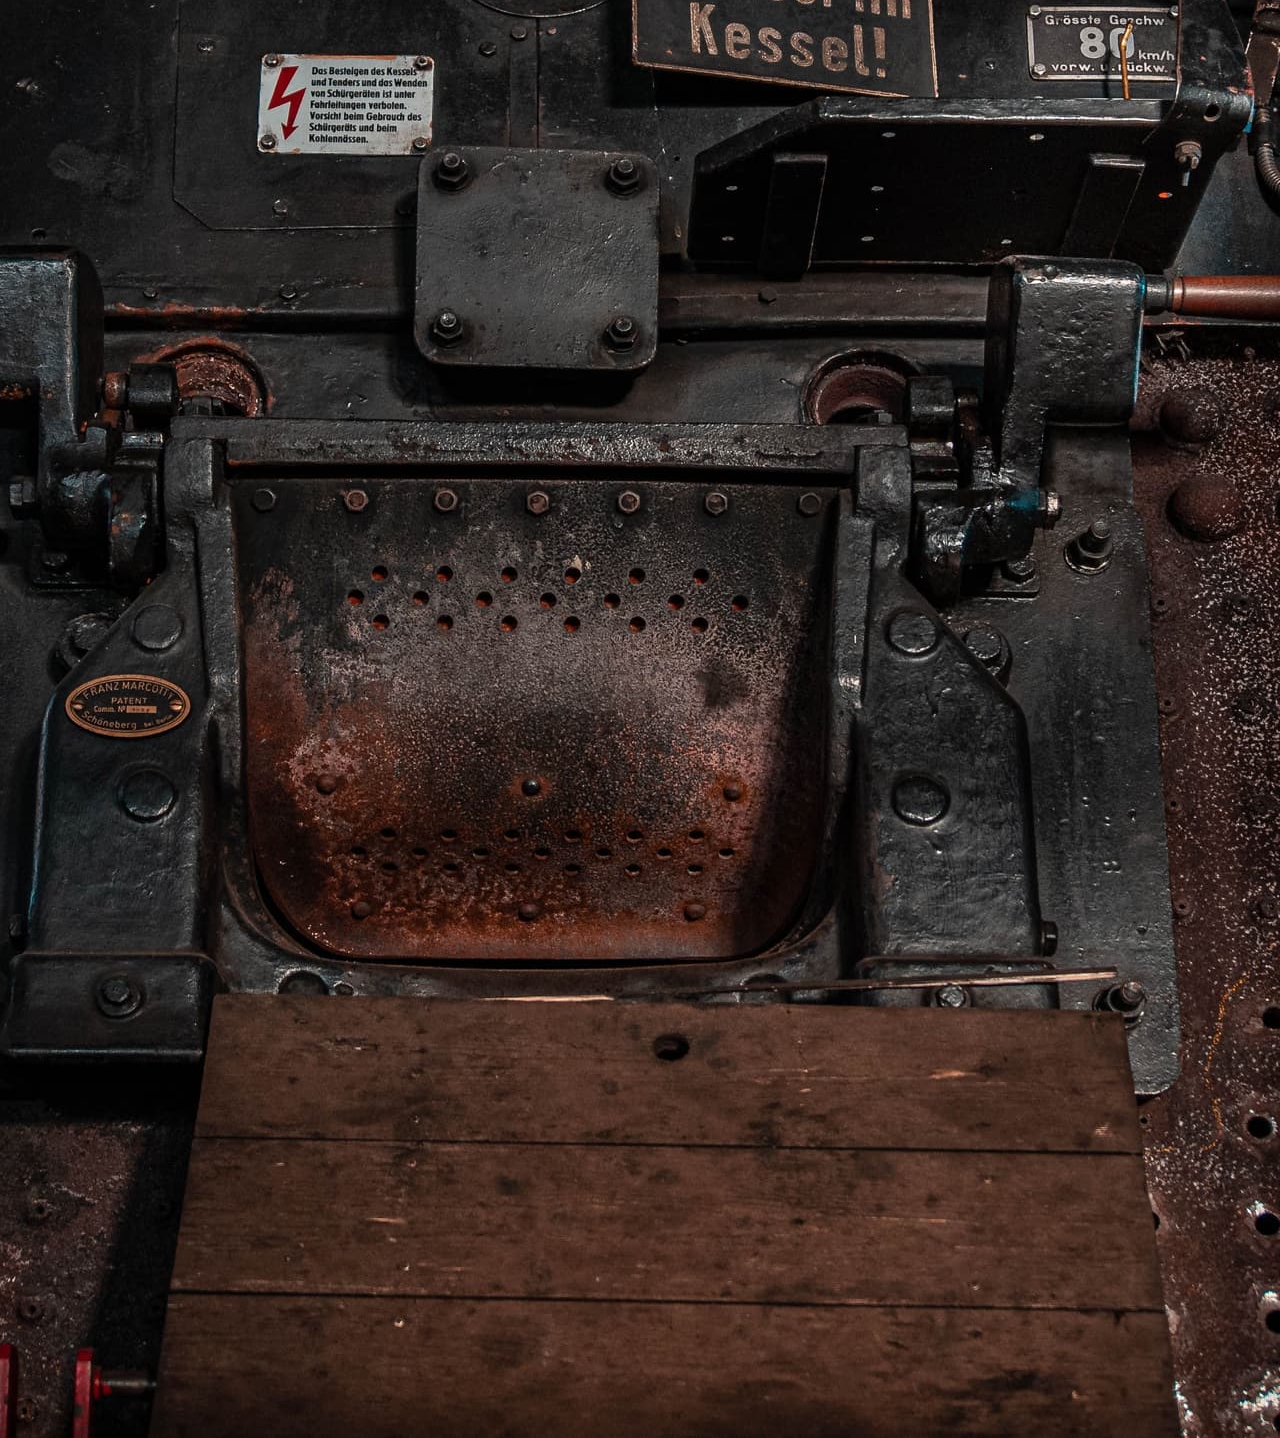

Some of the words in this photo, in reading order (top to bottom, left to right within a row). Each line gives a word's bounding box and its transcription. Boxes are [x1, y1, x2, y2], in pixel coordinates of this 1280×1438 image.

[1044, 14, 1102, 26] Grösste
[688, 1, 887, 79] Kessel!
[1079, 26, 1135, 59] 80
[1138, 49, 1175, 61] km/h
[312, 66, 328, 75] Das
[329, 66, 369, 77] Besteigen
[371, 67, 385, 76] des
[386, 67, 418, 76] Kessels
[1051, 63, 1095, 72] vorw.
[311, 78, 327, 87] und
[328, 78, 360, 87] Tenders
[361, 78, 377, 87] und
[378, 79, 393, 87] das
[394, 79, 428, 87] Wenden
[311, 90, 326, 98] von
[327, 89, 380, 99] Schürgeräten
[382, 89, 392, 98] ist
[394, 90, 416, 99] unter
[310, 100, 366, 110] Fahrleitungen
[369, 101, 407, 110] verboten.
[310, 111, 341, 121] Vorsicht
[343, 112, 364, 121] beim
[366, 112, 405, 122] Gebrauch
[407, 112, 422, 121] des
[309, 123, 357, 133] Schürgeräts
[357, 124, 374, 132] und
[376, 124, 397, 132] beim
[309, 134, 369, 144] Kohlennässen.
[82, 682, 120, 700] FRANZ
[111, 697, 148, 705] PATENT
